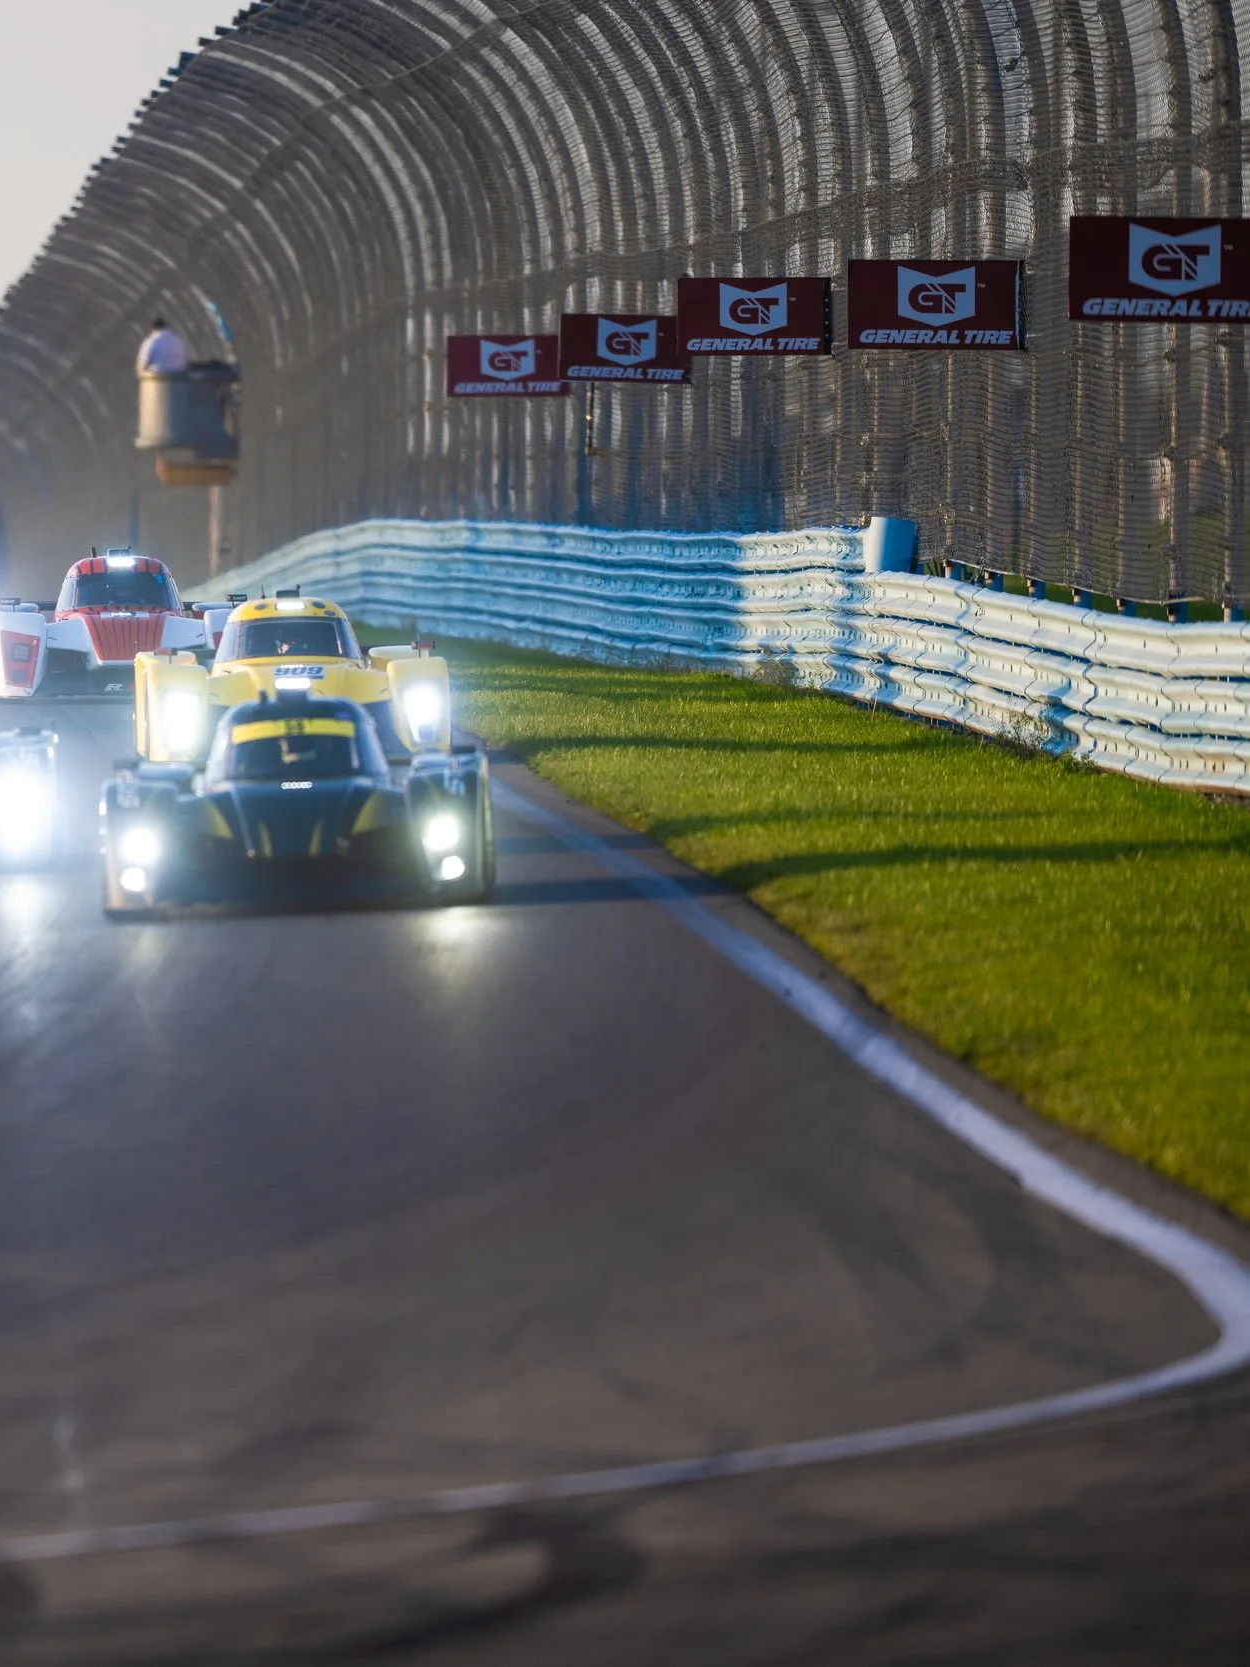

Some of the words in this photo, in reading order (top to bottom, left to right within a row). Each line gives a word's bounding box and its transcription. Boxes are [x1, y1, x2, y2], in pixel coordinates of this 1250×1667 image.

[1141, 244, 1211, 281] GT
[907, 283, 967, 314] GT
[728, 297, 780, 325] GT
[1082, 297, 1203, 317] GENERAL
[1206, 299, 1250, 318] TIR
[686, 337, 774, 351] GENERAL
[777, 337, 821, 350] TIRE
[859, 329, 960, 344] GENERAL
[963, 330, 1014, 345] TIRE
[567, 365, 644, 379] GENERAL
[646, 368, 685, 380] TIRE
[453, 382, 526, 394] GENERAL
[527, 381, 561, 393] TIRE
[274, 666, 324, 679] 909
